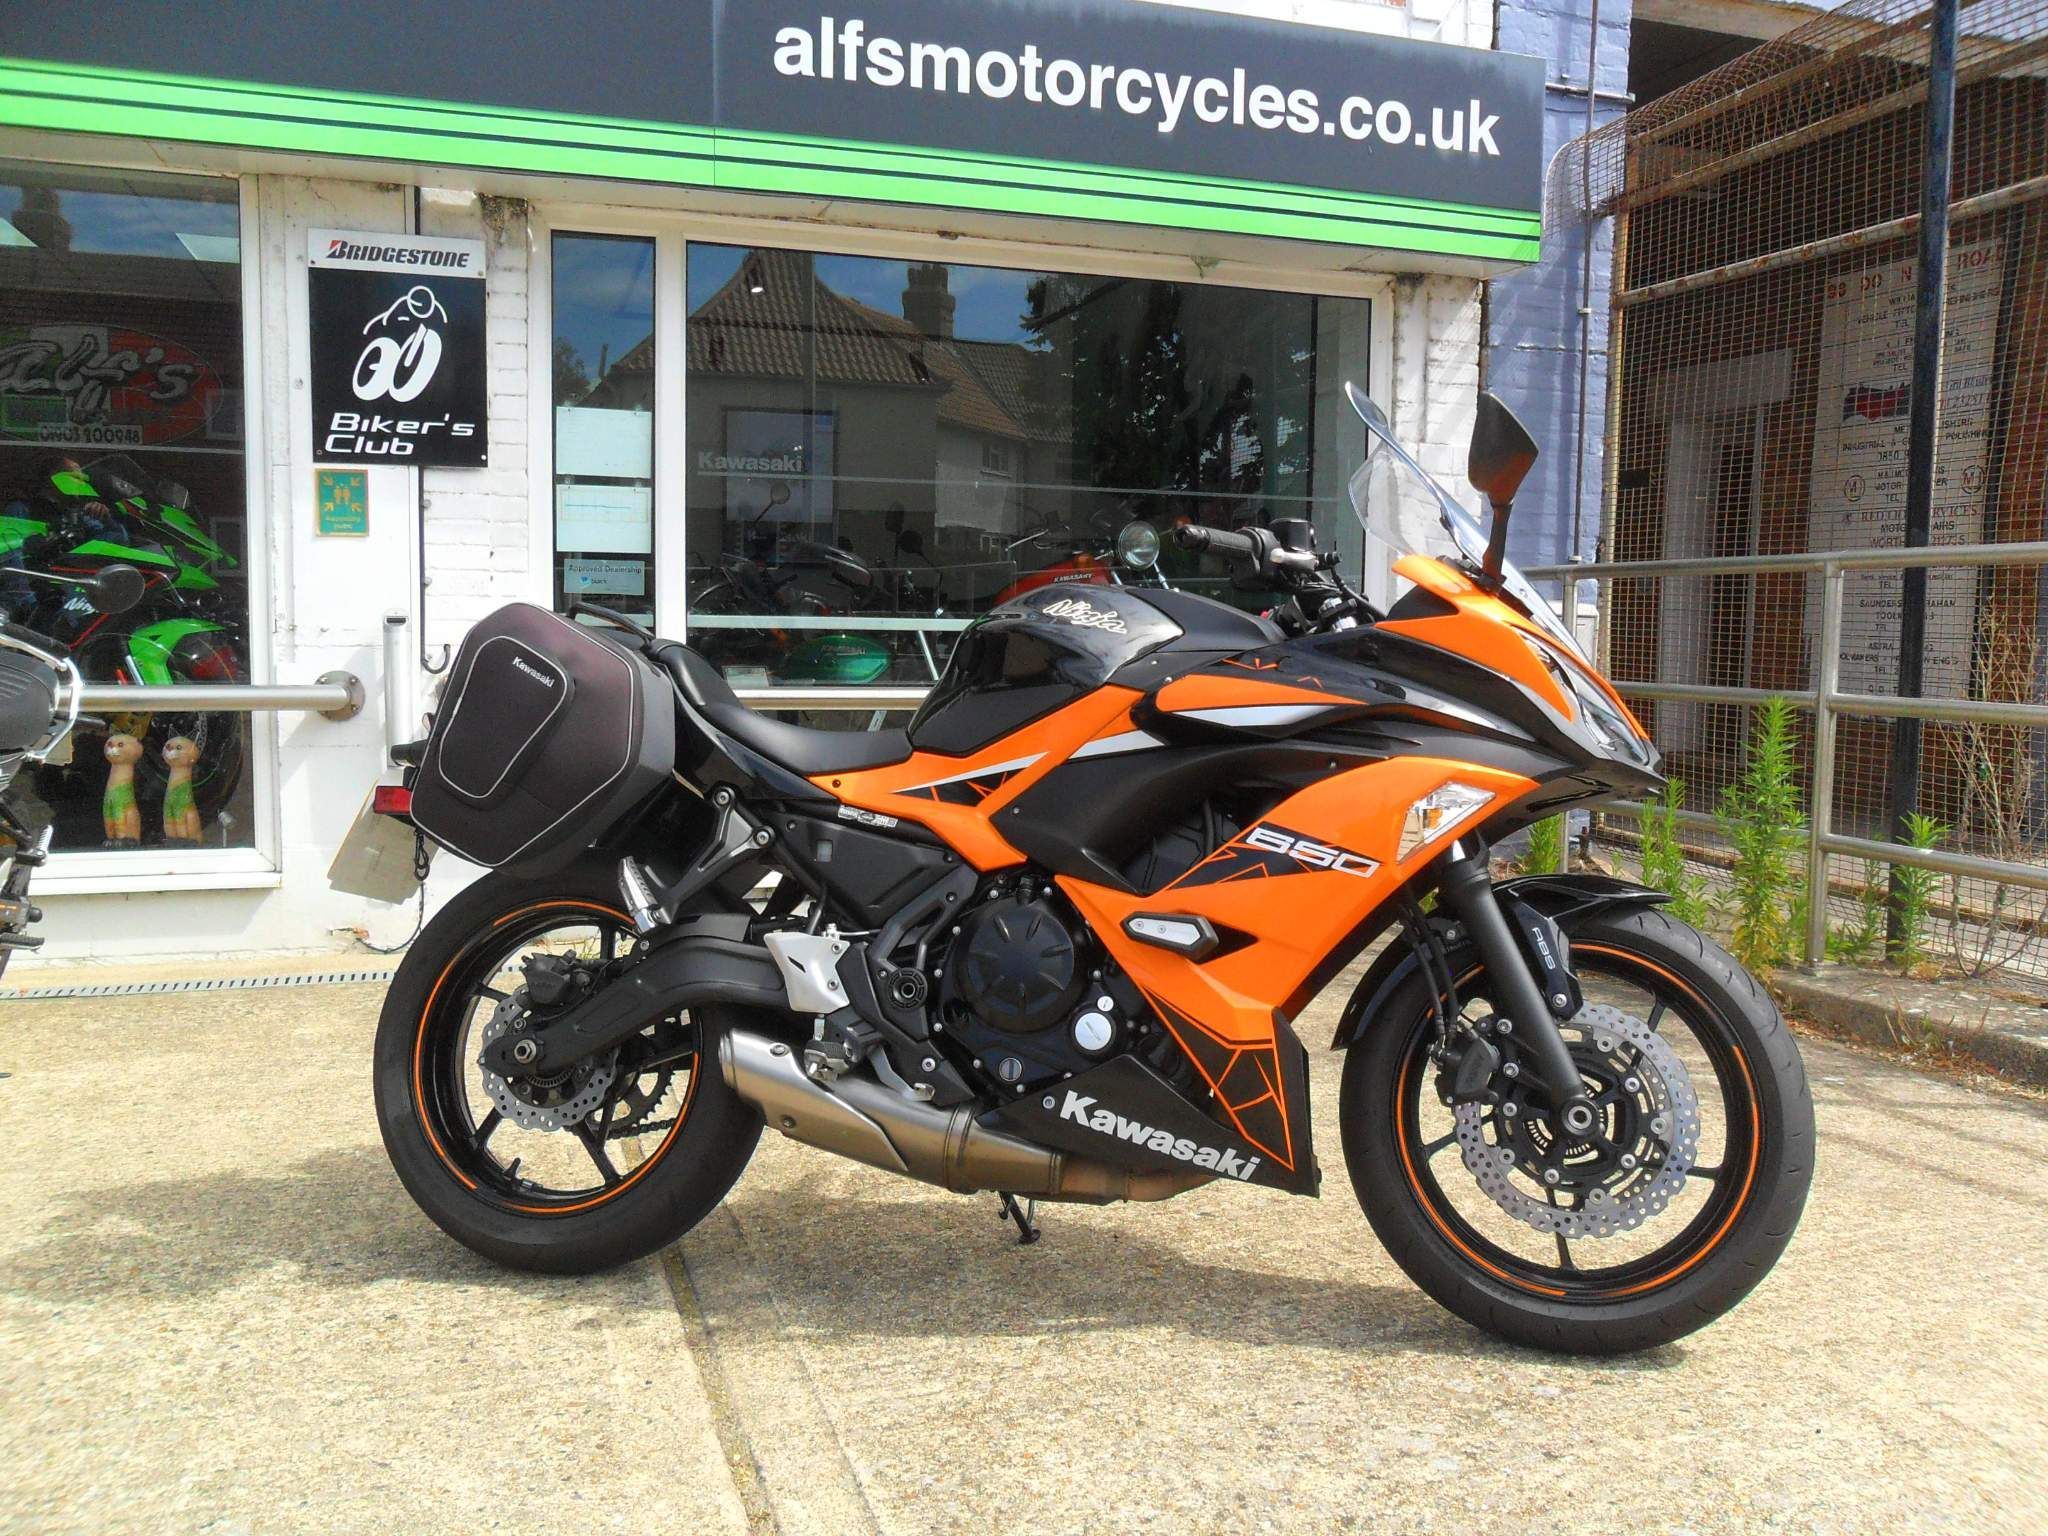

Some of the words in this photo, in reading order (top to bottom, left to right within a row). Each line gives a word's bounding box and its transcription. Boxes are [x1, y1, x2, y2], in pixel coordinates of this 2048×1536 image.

[773, 16, 1501, 157] alfsmotorcycles.co.uk
[326, 239, 469, 268] BRIDGESTONE
[329, 412, 476, 437] Biker's
[324, 434, 415, 456] Club
[697, 451, 802, 473] Kawasaki
[1042, 598, 1128, 635] Ninja
[512, 656, 555, 688] Kawasaki
[1245, 827, 1381, 879] 650
[1531, 927, 1556, 970] ABS
[1059, 1089, 1261, 1181] Kawasaki
